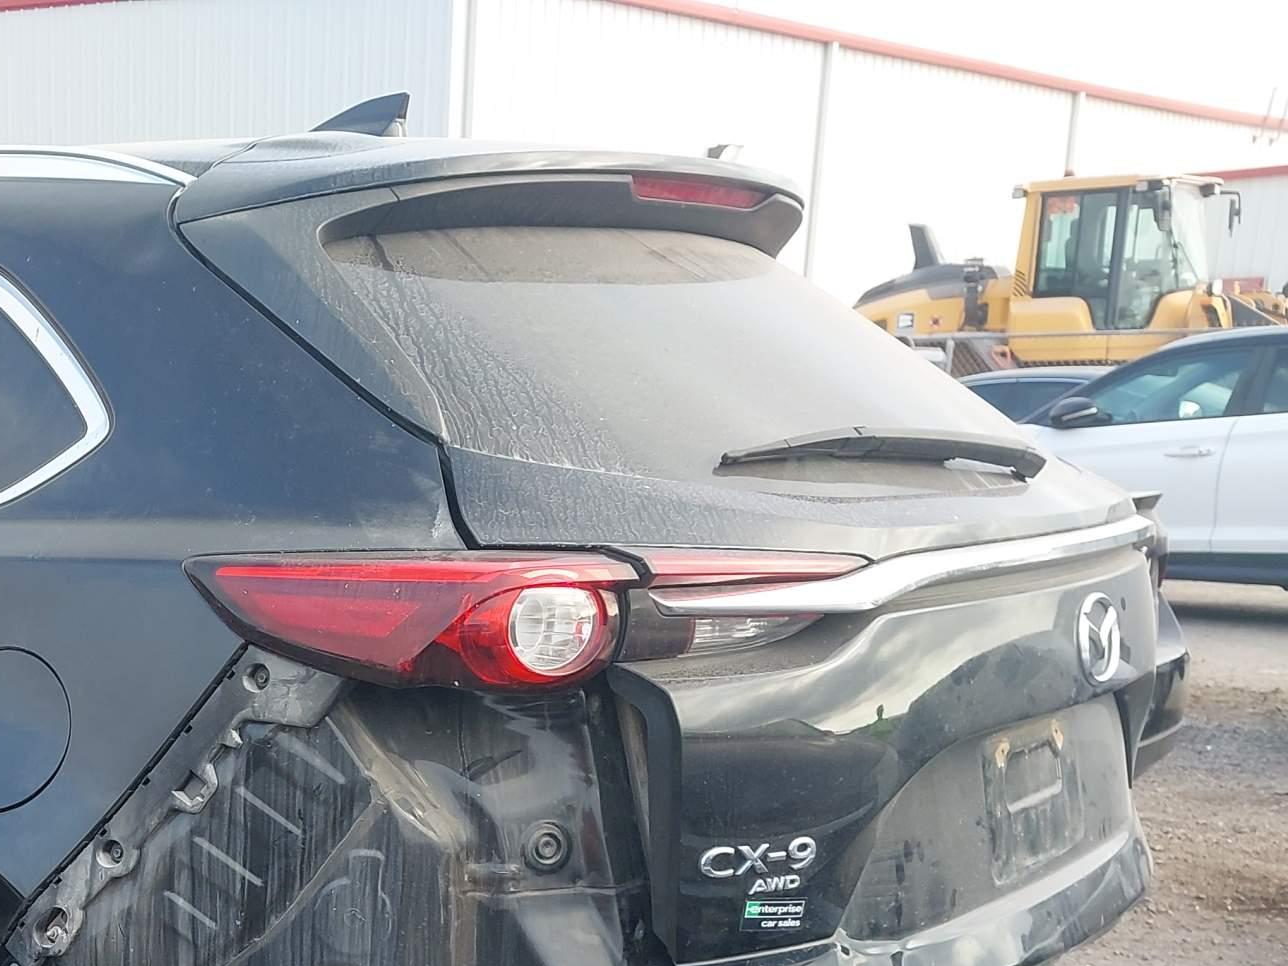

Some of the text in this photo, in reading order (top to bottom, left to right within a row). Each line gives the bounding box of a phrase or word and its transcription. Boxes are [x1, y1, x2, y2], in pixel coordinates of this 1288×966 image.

[700, 836, 817, 878] CX-9
[748, 874, 801, 895] AWD
[750, 904, 802, 915] enterprise
[761, 918, 801, 928] car sales
